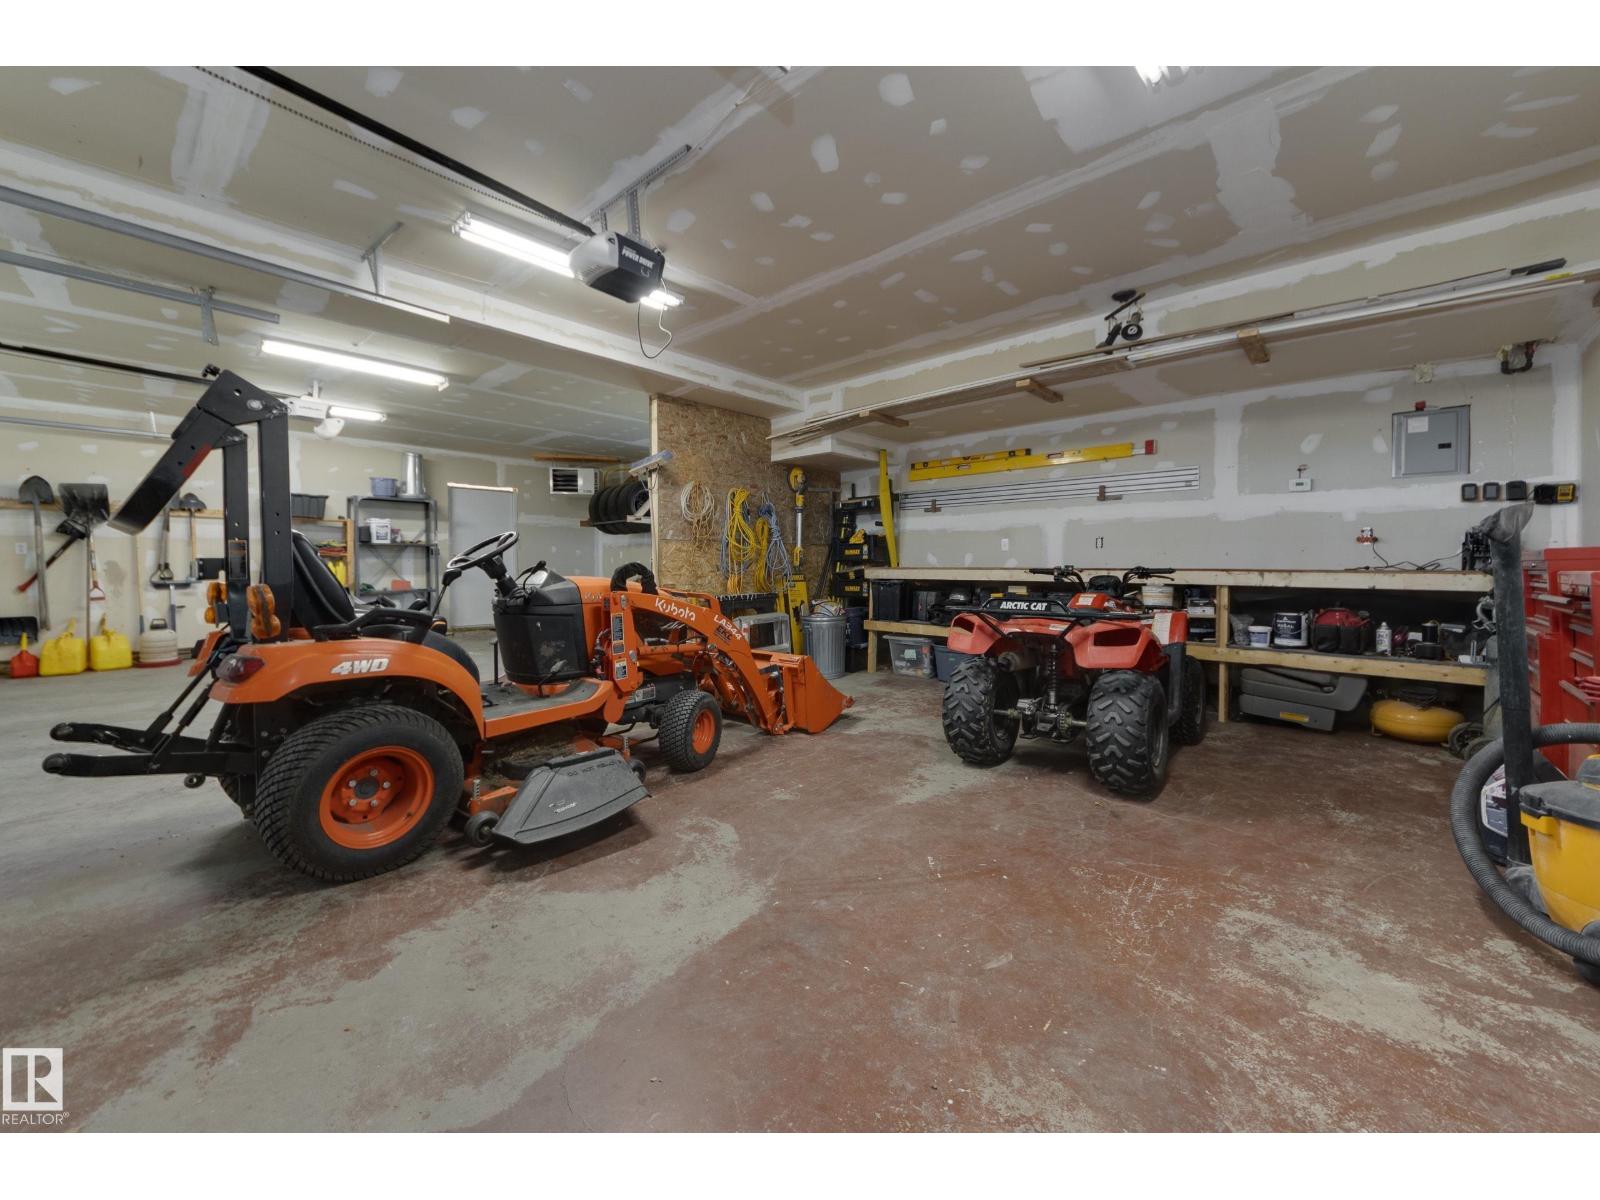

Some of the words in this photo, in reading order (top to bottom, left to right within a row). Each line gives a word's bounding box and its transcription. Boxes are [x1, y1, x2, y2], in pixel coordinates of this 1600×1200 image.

[655, 597, 696, 621] Kubota
[1000, 601, 1028, 611] ARCTIC
[1030, 602, 1048, 611] CAT
[713, 614, 743, 640] LA344
[330, 658, 389, 675] 4WD
